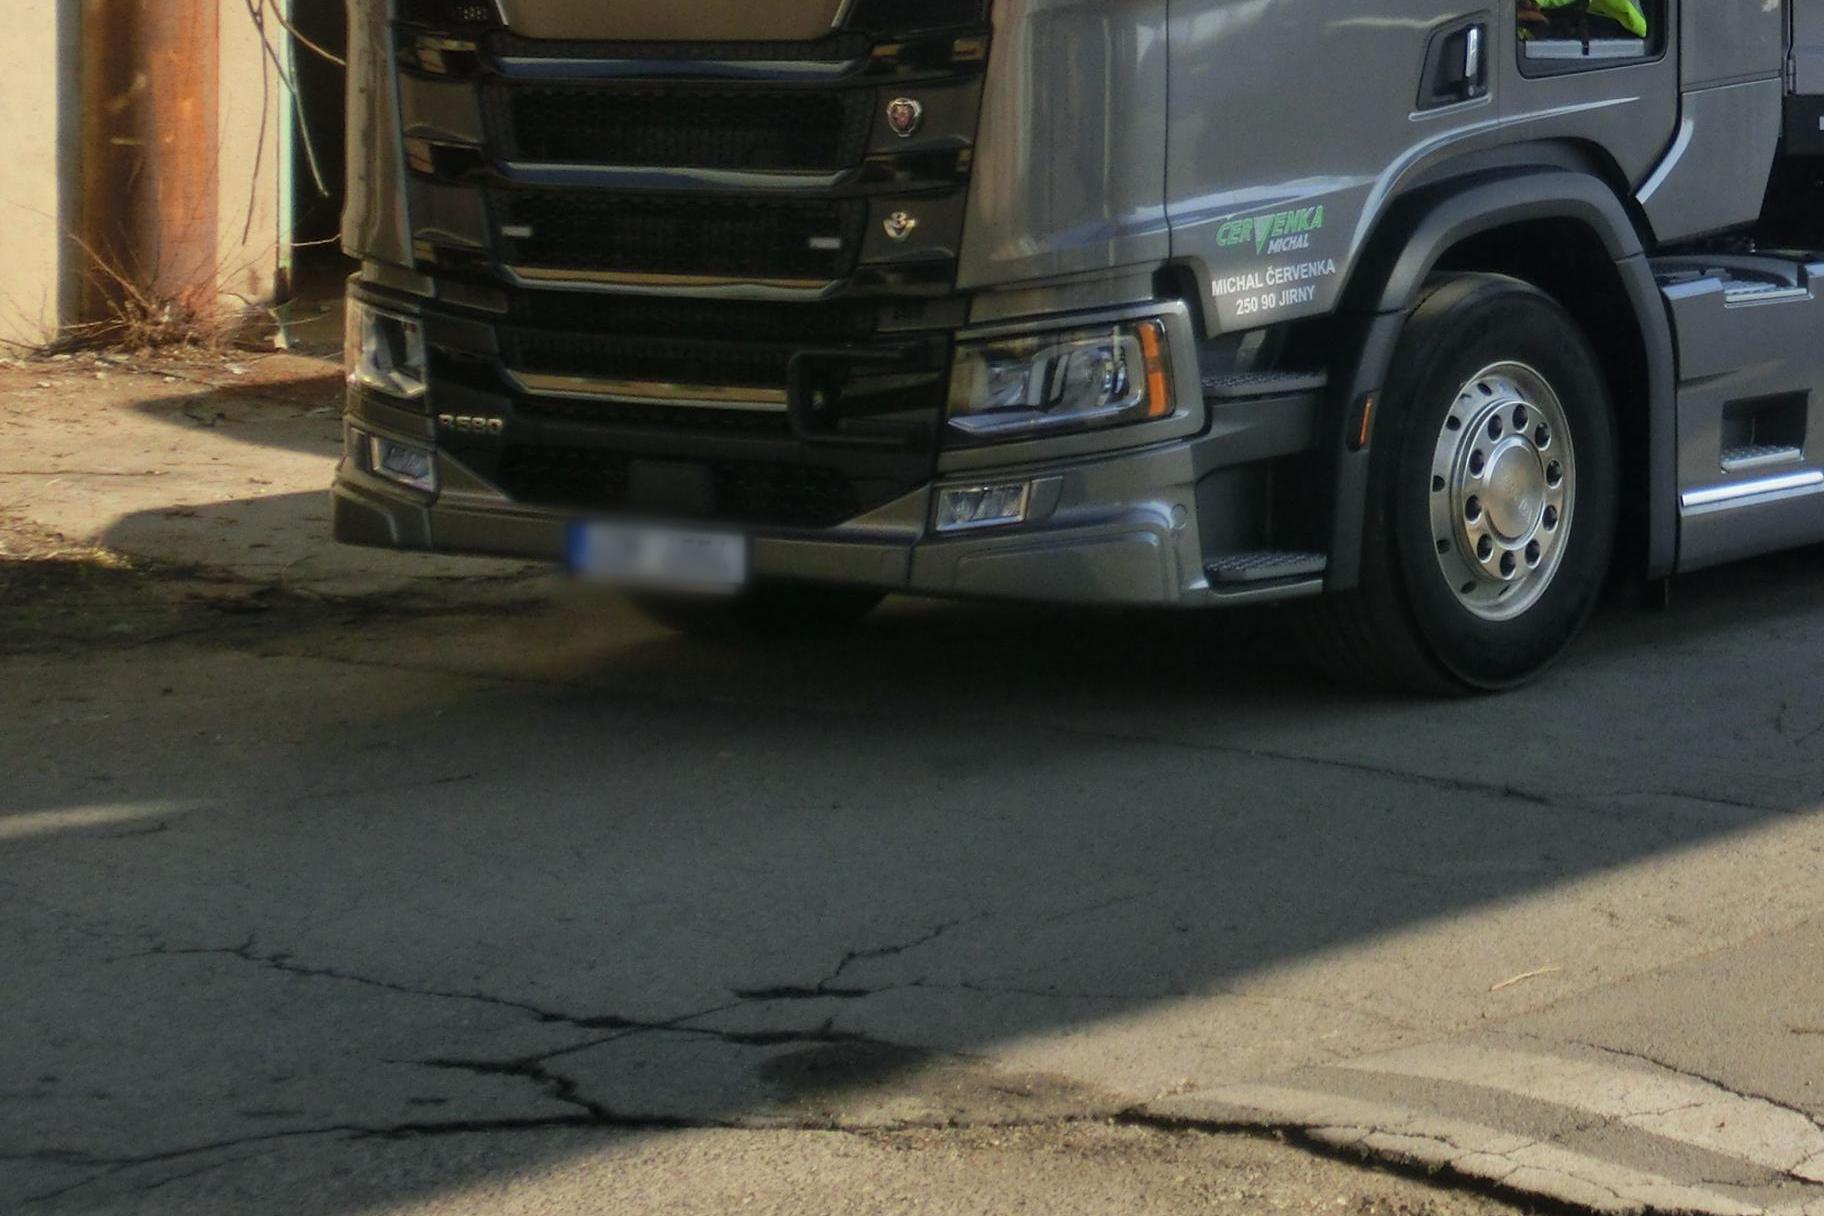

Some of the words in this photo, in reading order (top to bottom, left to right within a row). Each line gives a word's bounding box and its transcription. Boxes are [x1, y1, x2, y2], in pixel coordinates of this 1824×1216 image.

[1267, 234, 1309, 254] MICHAL
[1212, 273, 1264, 296] MICHAL
[1266, 259, 1335, 285] ČERVENKA
[1236, 297, 1258, 315] 250
[1261, 293, 1275, 310] 90
[1279, 286, 1315, 306] JIRNY
